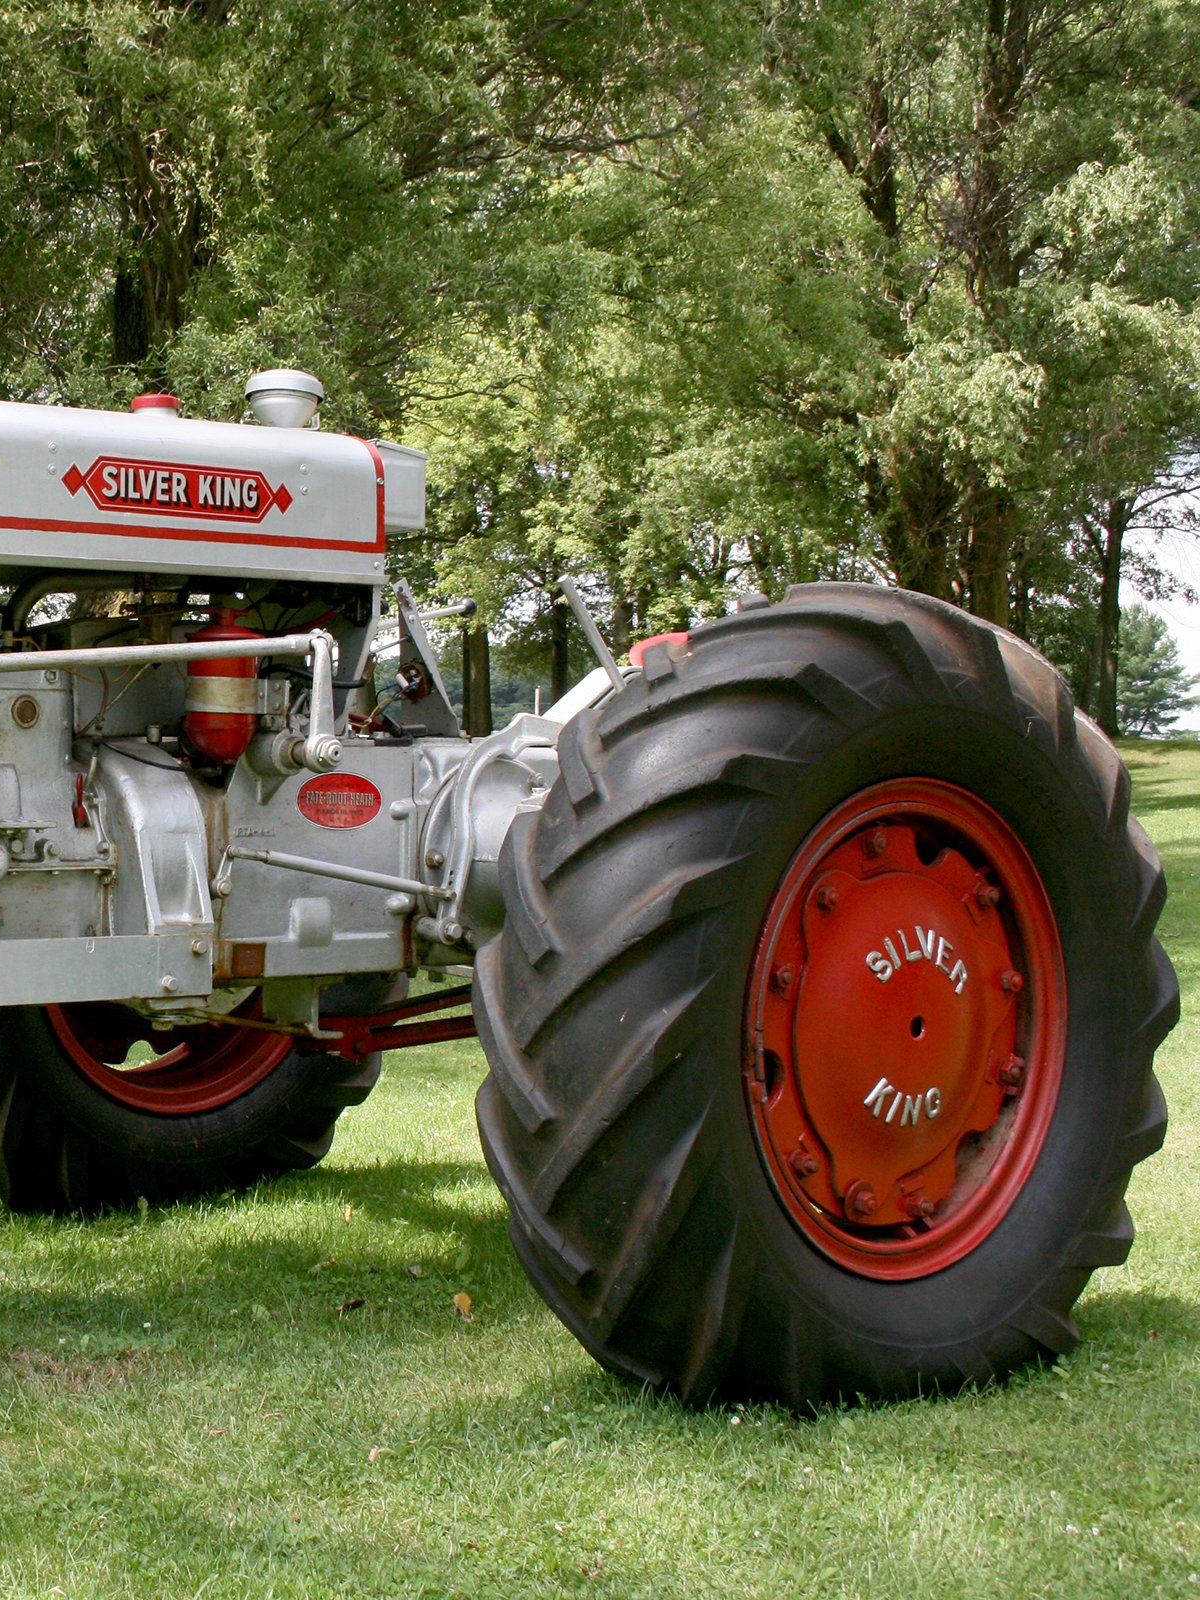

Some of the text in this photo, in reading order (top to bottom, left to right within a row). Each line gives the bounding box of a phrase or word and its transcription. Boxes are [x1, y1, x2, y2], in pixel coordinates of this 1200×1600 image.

[101, 465, 260, 511] SILVER KING
[866, 926, 968, 995] SILVER
[864, 1077, 942, 1127] KING
